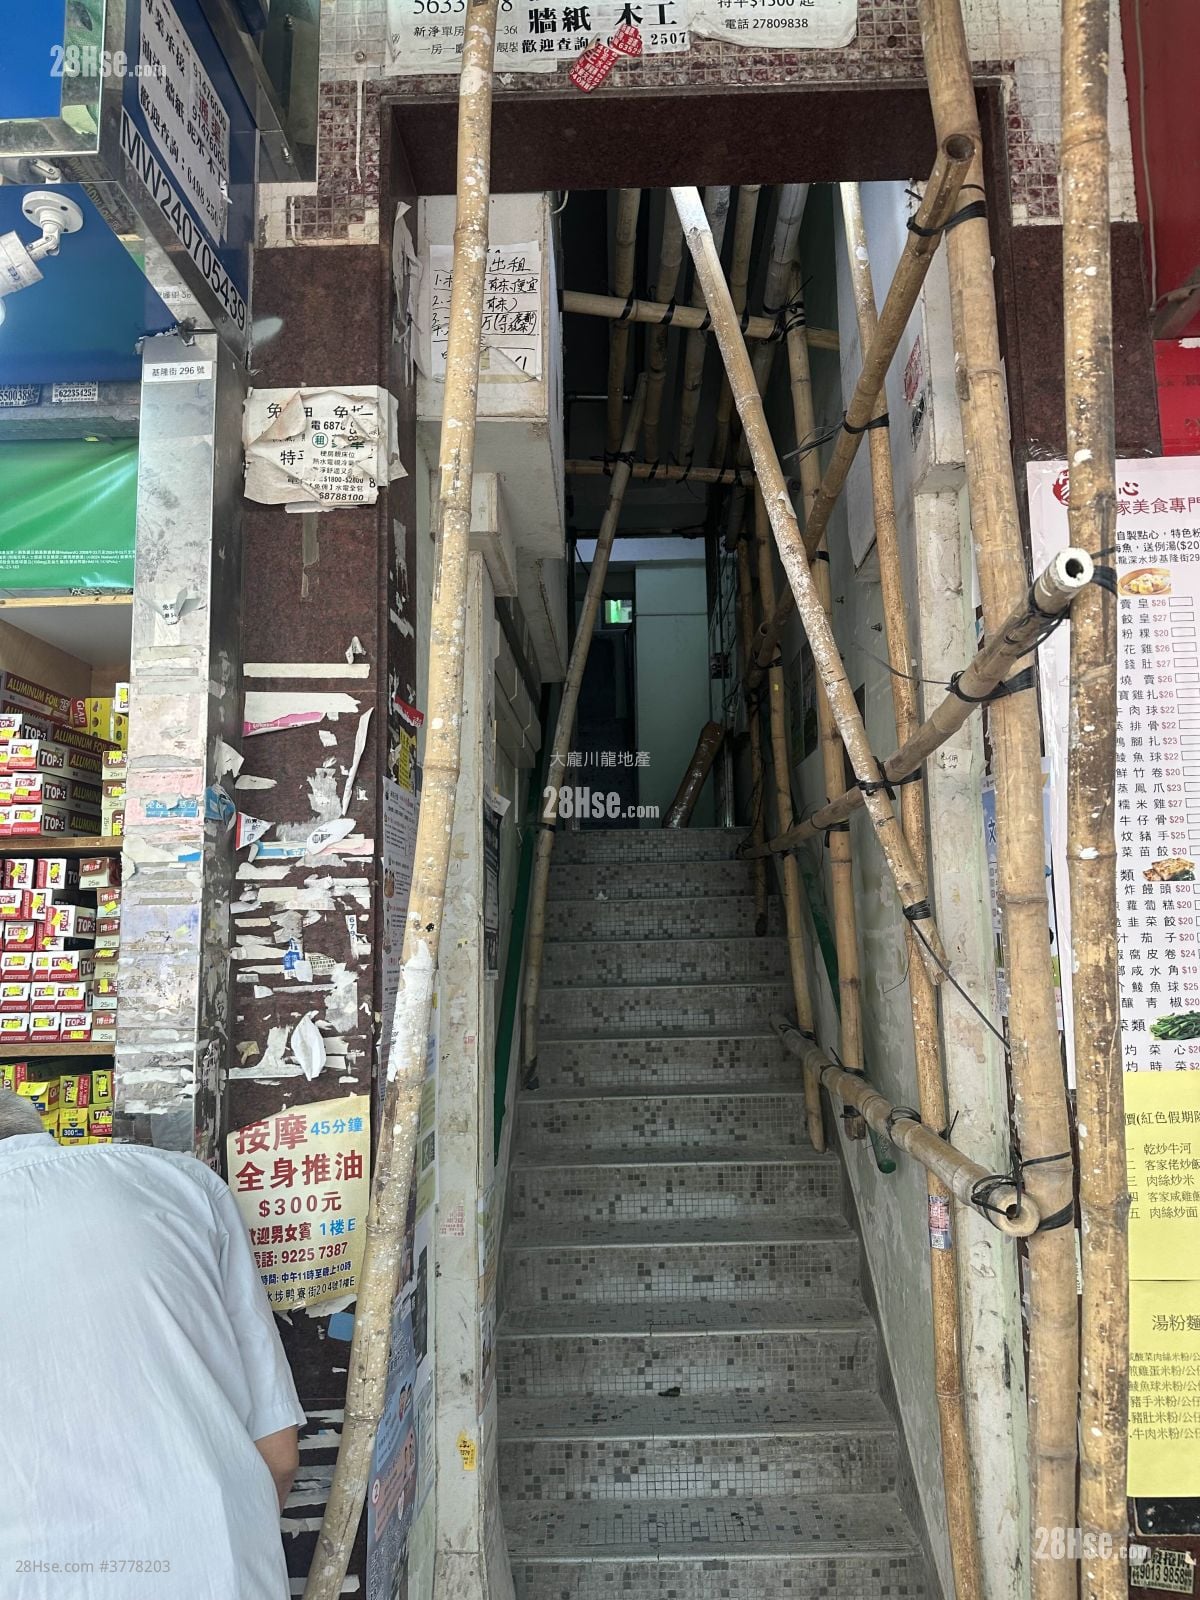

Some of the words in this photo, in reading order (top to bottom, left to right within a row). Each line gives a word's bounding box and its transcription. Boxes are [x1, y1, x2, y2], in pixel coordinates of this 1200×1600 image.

[528, 6, 592, 34] 牆紙
[615, 1, 677, 26] 木工
[725, 19, 749, 30] 電話
[753, 19, 808, 28] 27809838
[521, 37, 589, 54] 歡迎查詢
[651, 32, 687, 46] 2507
[122, 111, 247, 332] MW240705439
[152, 367, 177, 377] 基隆街
[179, 367, 194, 375] 296
[197, 366, 205, 374] 號
[1153, 614, 1167, 622] $27
[7, 677, 45, 701] ALUMINUM
[54, 728, 93, 750] ALUMINUM
[1163, 737, 1178, 745] $23
[1167, 784, 1182, 792] $23
[1172, 847, 1187, 855] $20
[1175, 885, 1191, 893] $20
[1178, 917, 1193, 925] $20
[1180, 950, 1196, 958] $24
[1182, 966, 1198, 974] $19
[1183, 983, 1199, 991] $25
[1184, 998, 1200, 1006] $20
[235, 1113, 308, 1156] 按摩
[310, 1117, 363, 1136] 45分鐘
[235, 1150, 363, 1193] 全身推油
[259, 1191, 342, 1218] $300元
[282, 1248, 315, 1264] 9225
[319, 1242, 348, 1260] 7387
[1140, 1563, 1161, 1581] 9013
[1163, 1566, 1185, 1585] 9858
